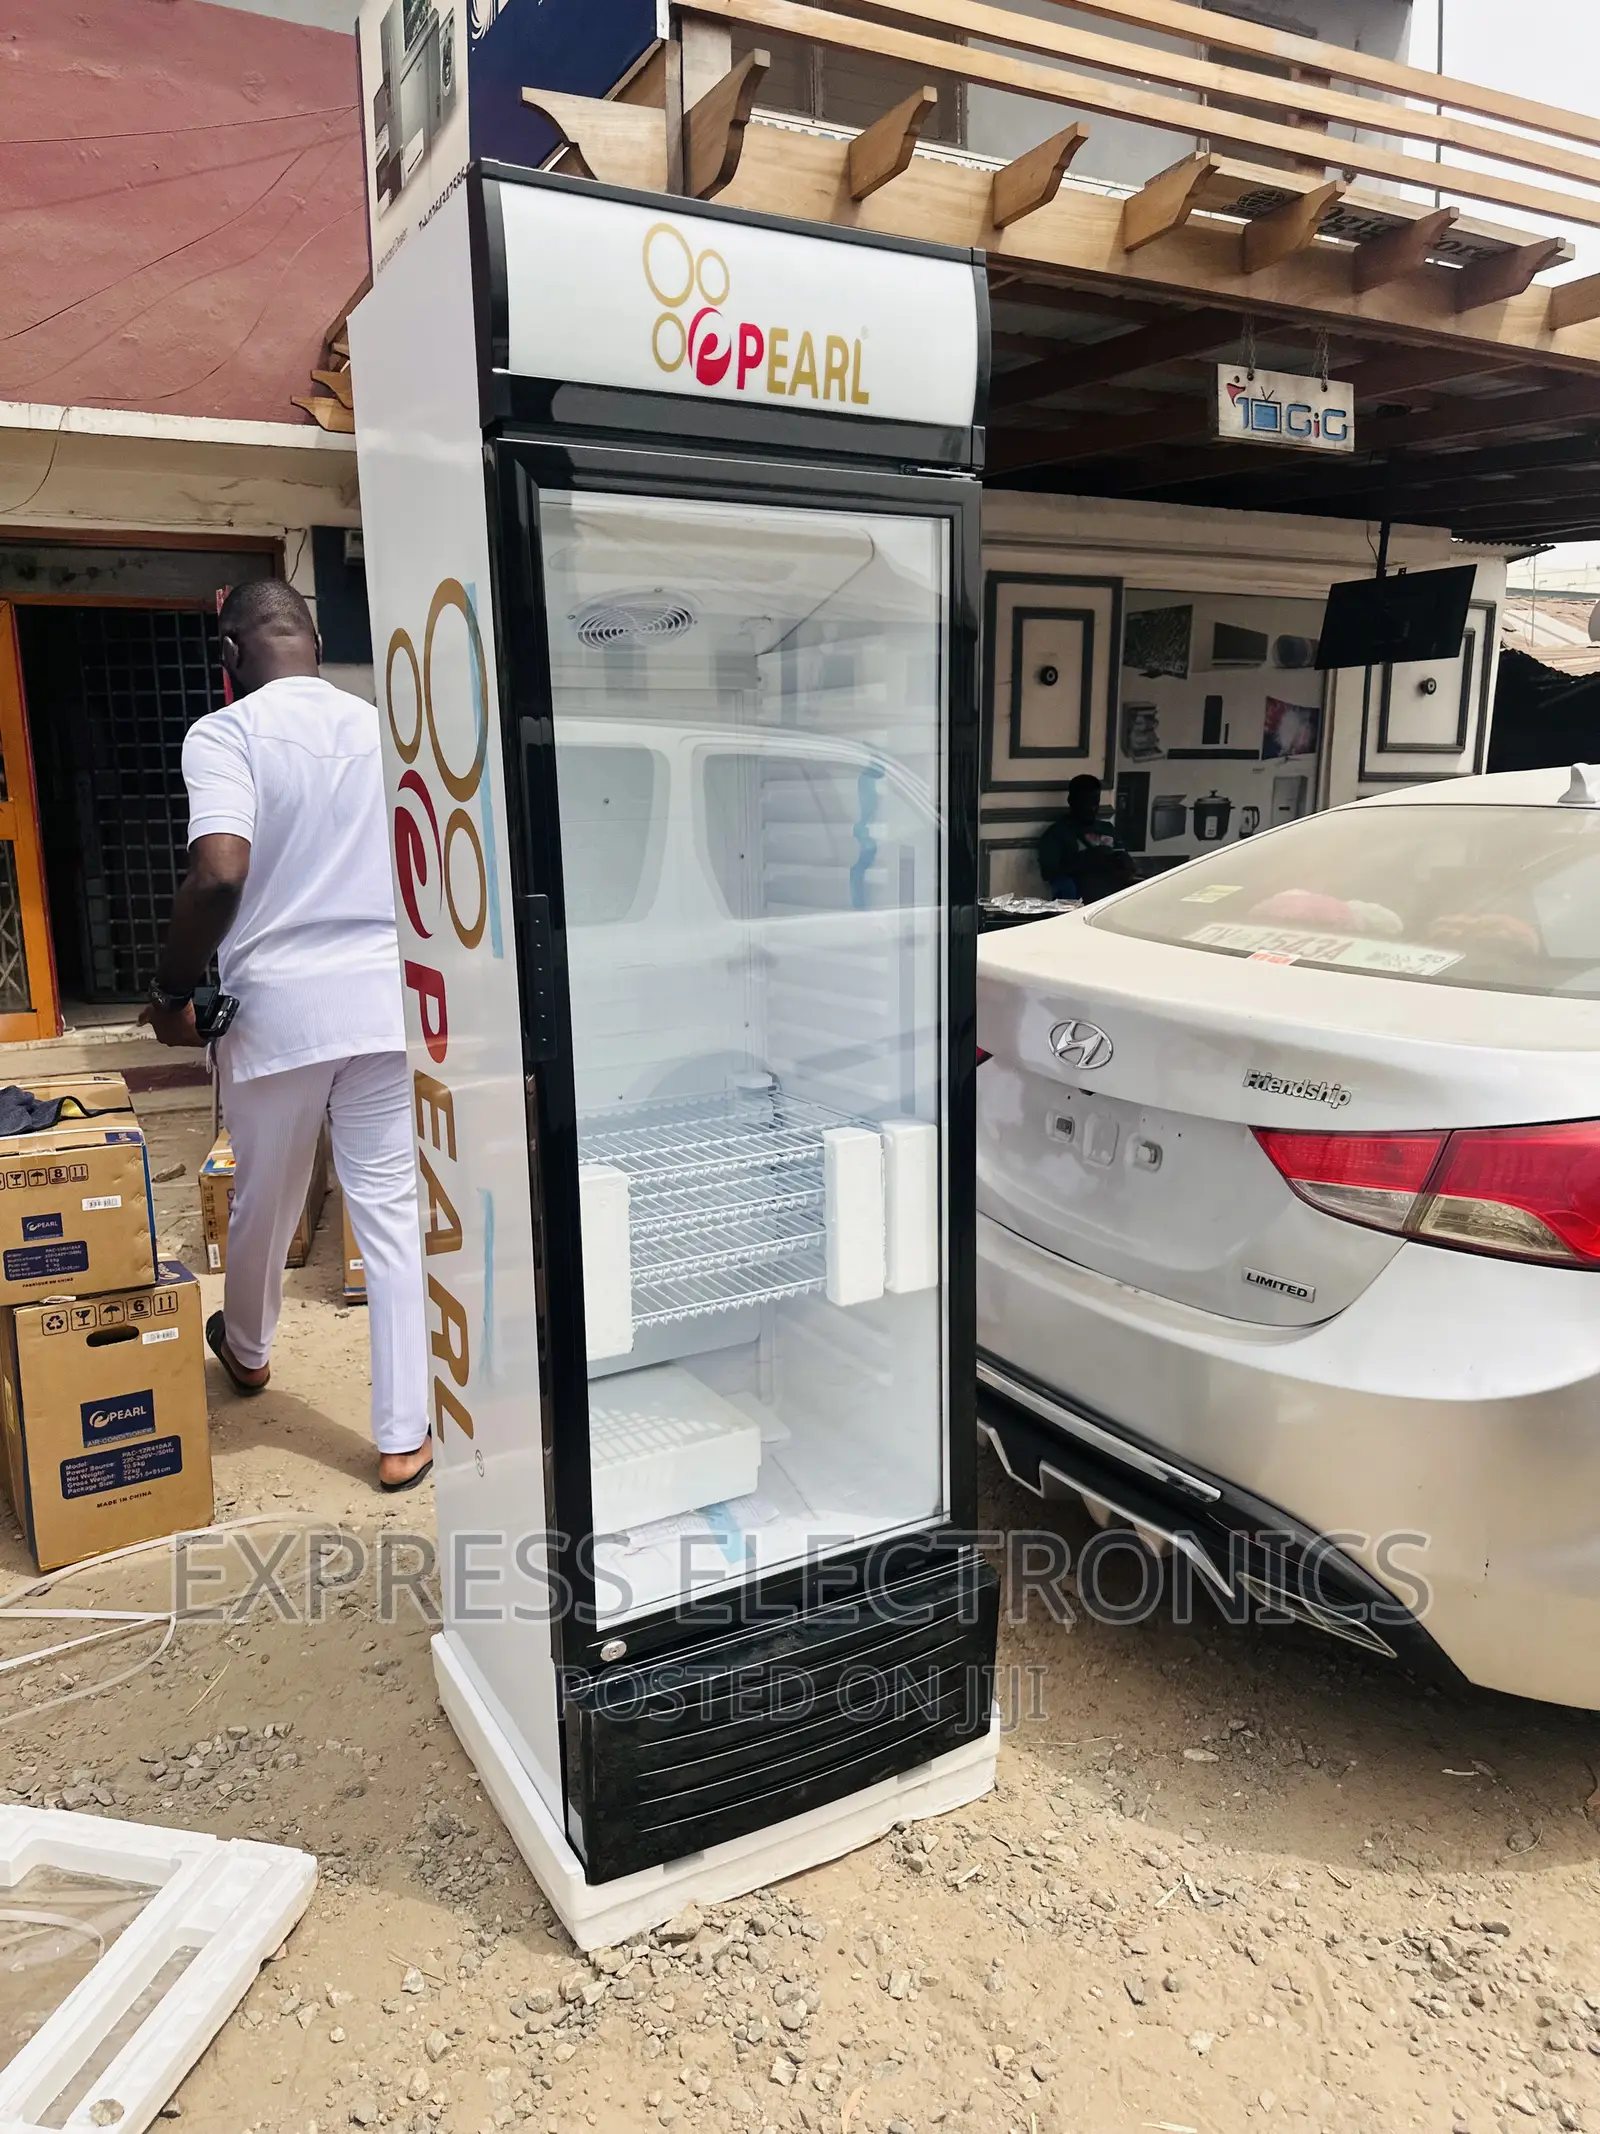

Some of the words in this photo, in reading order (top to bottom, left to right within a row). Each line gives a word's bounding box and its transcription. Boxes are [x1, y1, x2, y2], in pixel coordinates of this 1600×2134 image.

[736, 322, 870, 405] PEARL
[1242, 1069, 1352, 1109] Friendship
[404, 959, 474, 1443] PEARL
[1246, 1272, 1308, 1298] LIMITED
[133, 1299, 144, 1312] 6
[109, 1405, 147, 1421] PEARL
[67, 1484, 97, 1495] Package
[97, 1499, 117, 1508] MADE
[129, 1490, 152, 1501] CHINA
